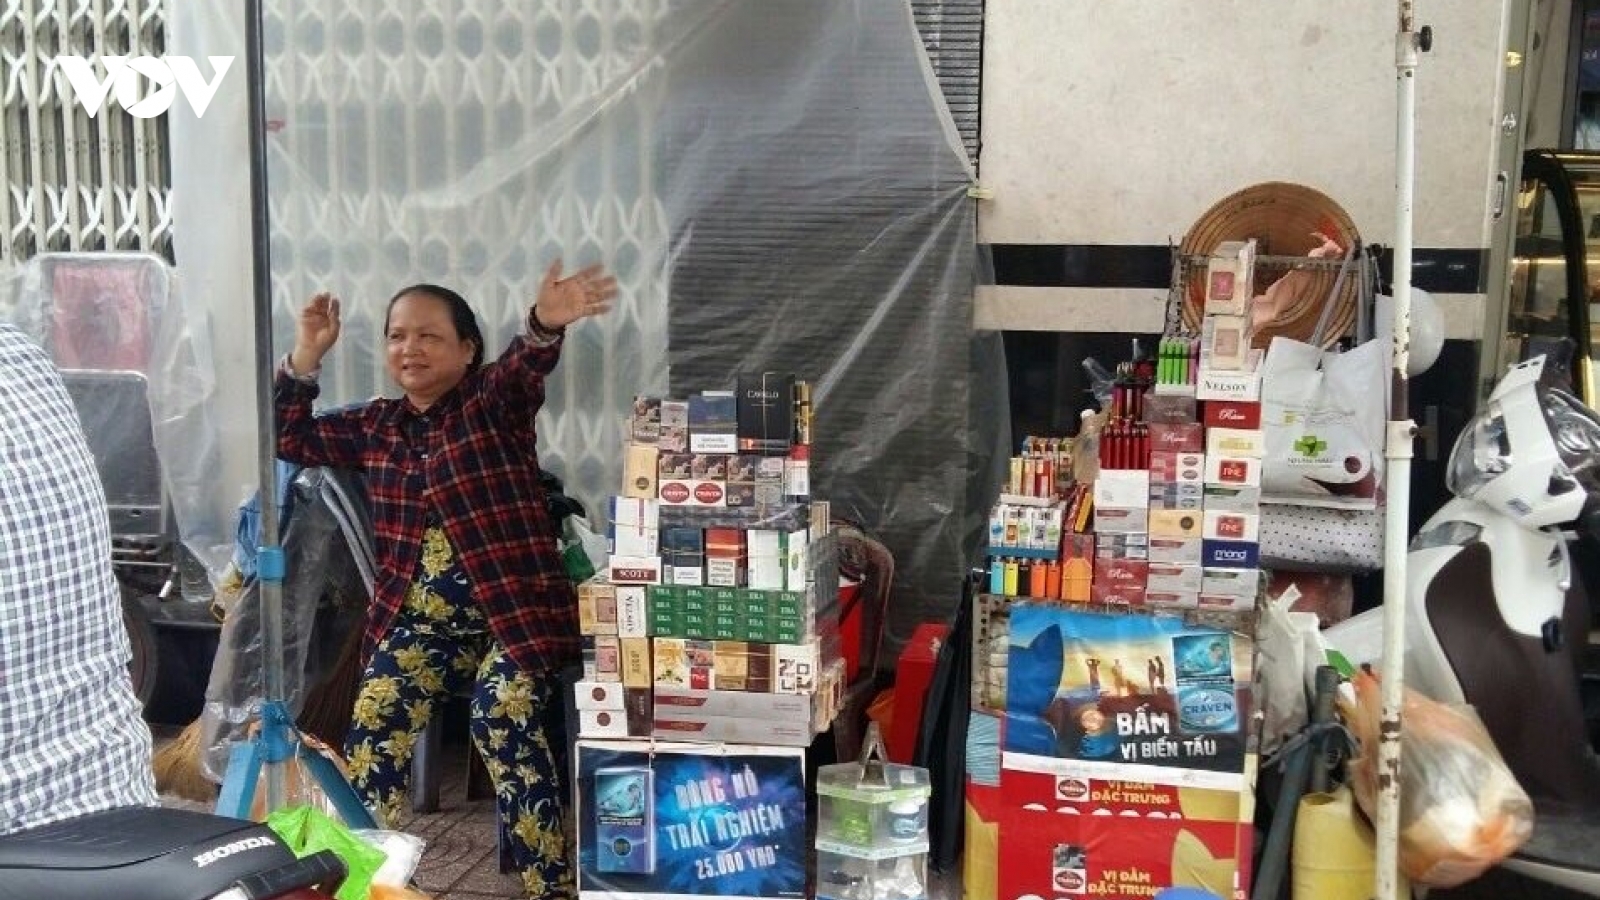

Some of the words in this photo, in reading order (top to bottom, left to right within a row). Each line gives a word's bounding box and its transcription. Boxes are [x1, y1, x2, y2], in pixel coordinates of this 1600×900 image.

[619, 568, 650, 578] SCOTT
[1116, 702, 1170, 736] BẤM
[1182, 702, 1233, 715] CRAVEN
[1120, 742, 1137, 762] VỊ
[1141, 736, 1178, 759] BIẾN
[1182, 734, 1217, 757] TẤU
[714, 803, 785, 841] NGHIỆM
[193, 836, 276, 868] HONDA
[695, 851, 745, 880] 25.000
[1118, 884, 1160, 896] TRƯN
